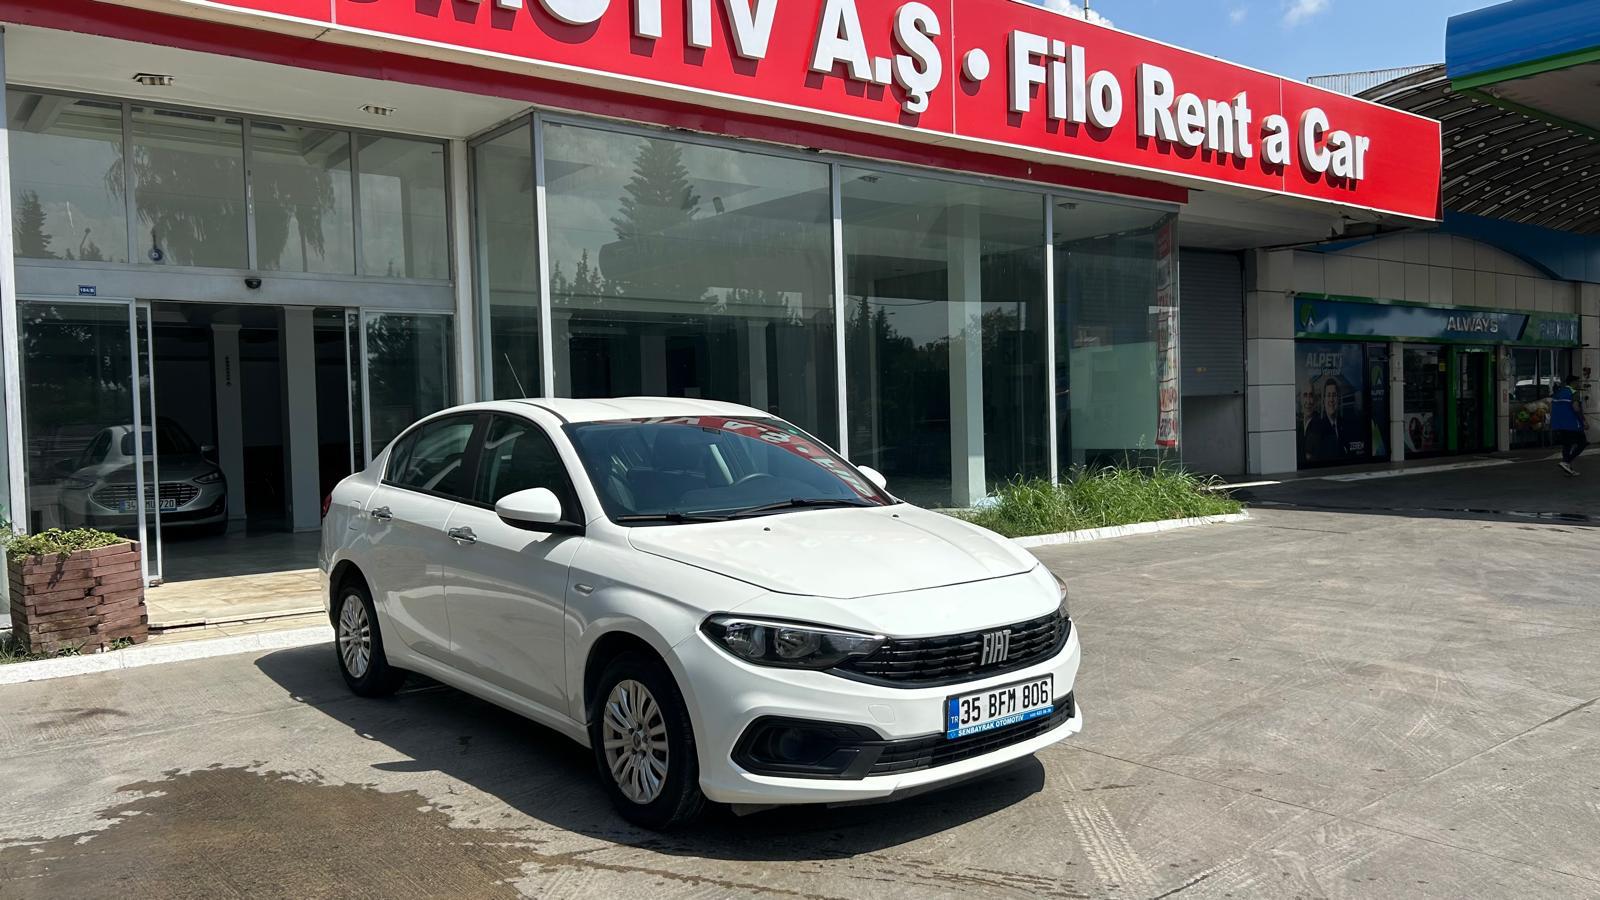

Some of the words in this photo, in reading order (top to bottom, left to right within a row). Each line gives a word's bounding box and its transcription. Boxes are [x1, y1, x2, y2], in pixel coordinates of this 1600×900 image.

[1010, 30, 1124, 129] Filo
[1137, 63, 1253, 159] Rent
[1262, 115, 1291, 166] a
[1299, 107, 1370, 181] Car
[1447, 316, 1498, 333] ALWAYS
[980, 629, 1012, 666] FIAT
[950, 716, 959, 724] TR
[960, 696, 981, 725] 35
[988, 688, 1016, 718] BFM
[1022, 680, 1049, 709] 806
